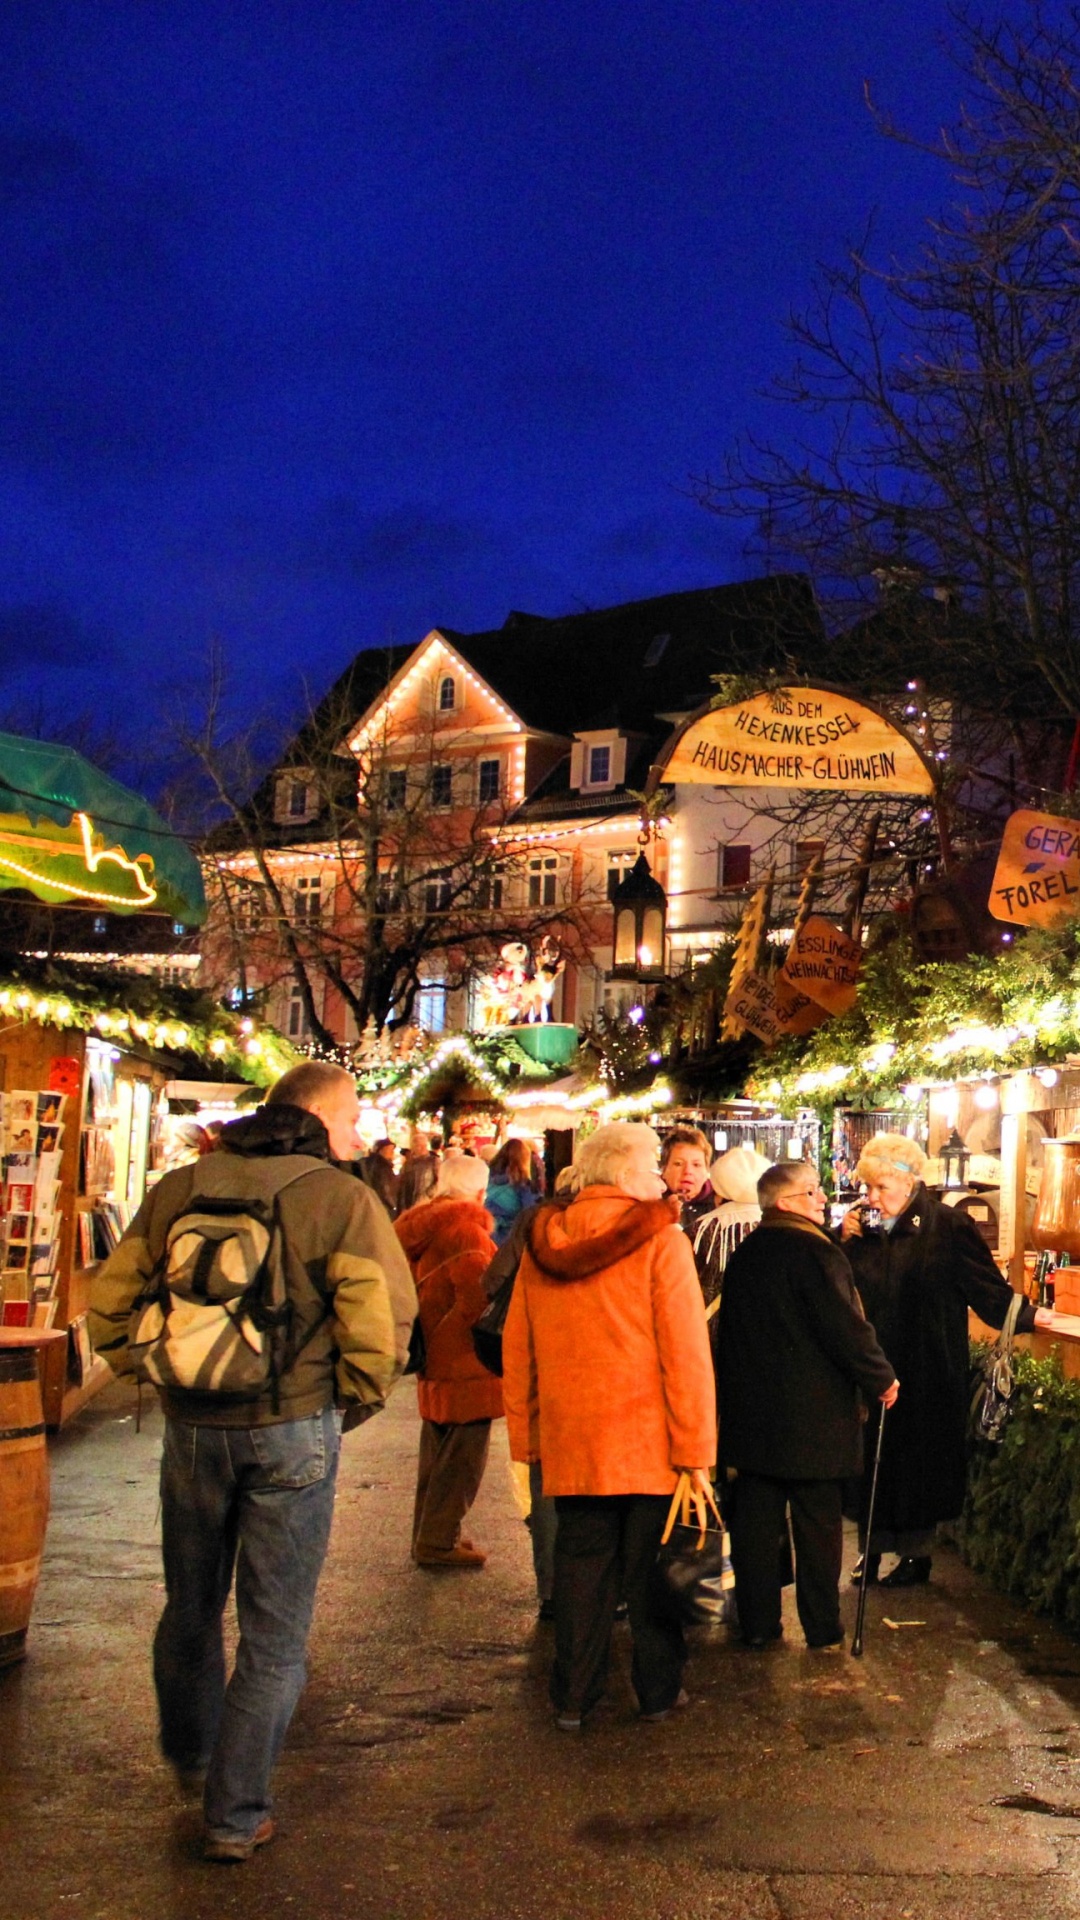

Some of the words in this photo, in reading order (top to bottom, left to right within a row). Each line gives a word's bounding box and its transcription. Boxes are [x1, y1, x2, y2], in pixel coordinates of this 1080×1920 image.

[771, 698, 793, 715] AUS
[798, 702, 822, 718] DEM
[734, 710, 860, 746] HEXENKESSEL
[692, 740, 897, 781] HAUSMACHER-GLÜHWEIN
[996, 871, 1080, 915] FOREL
